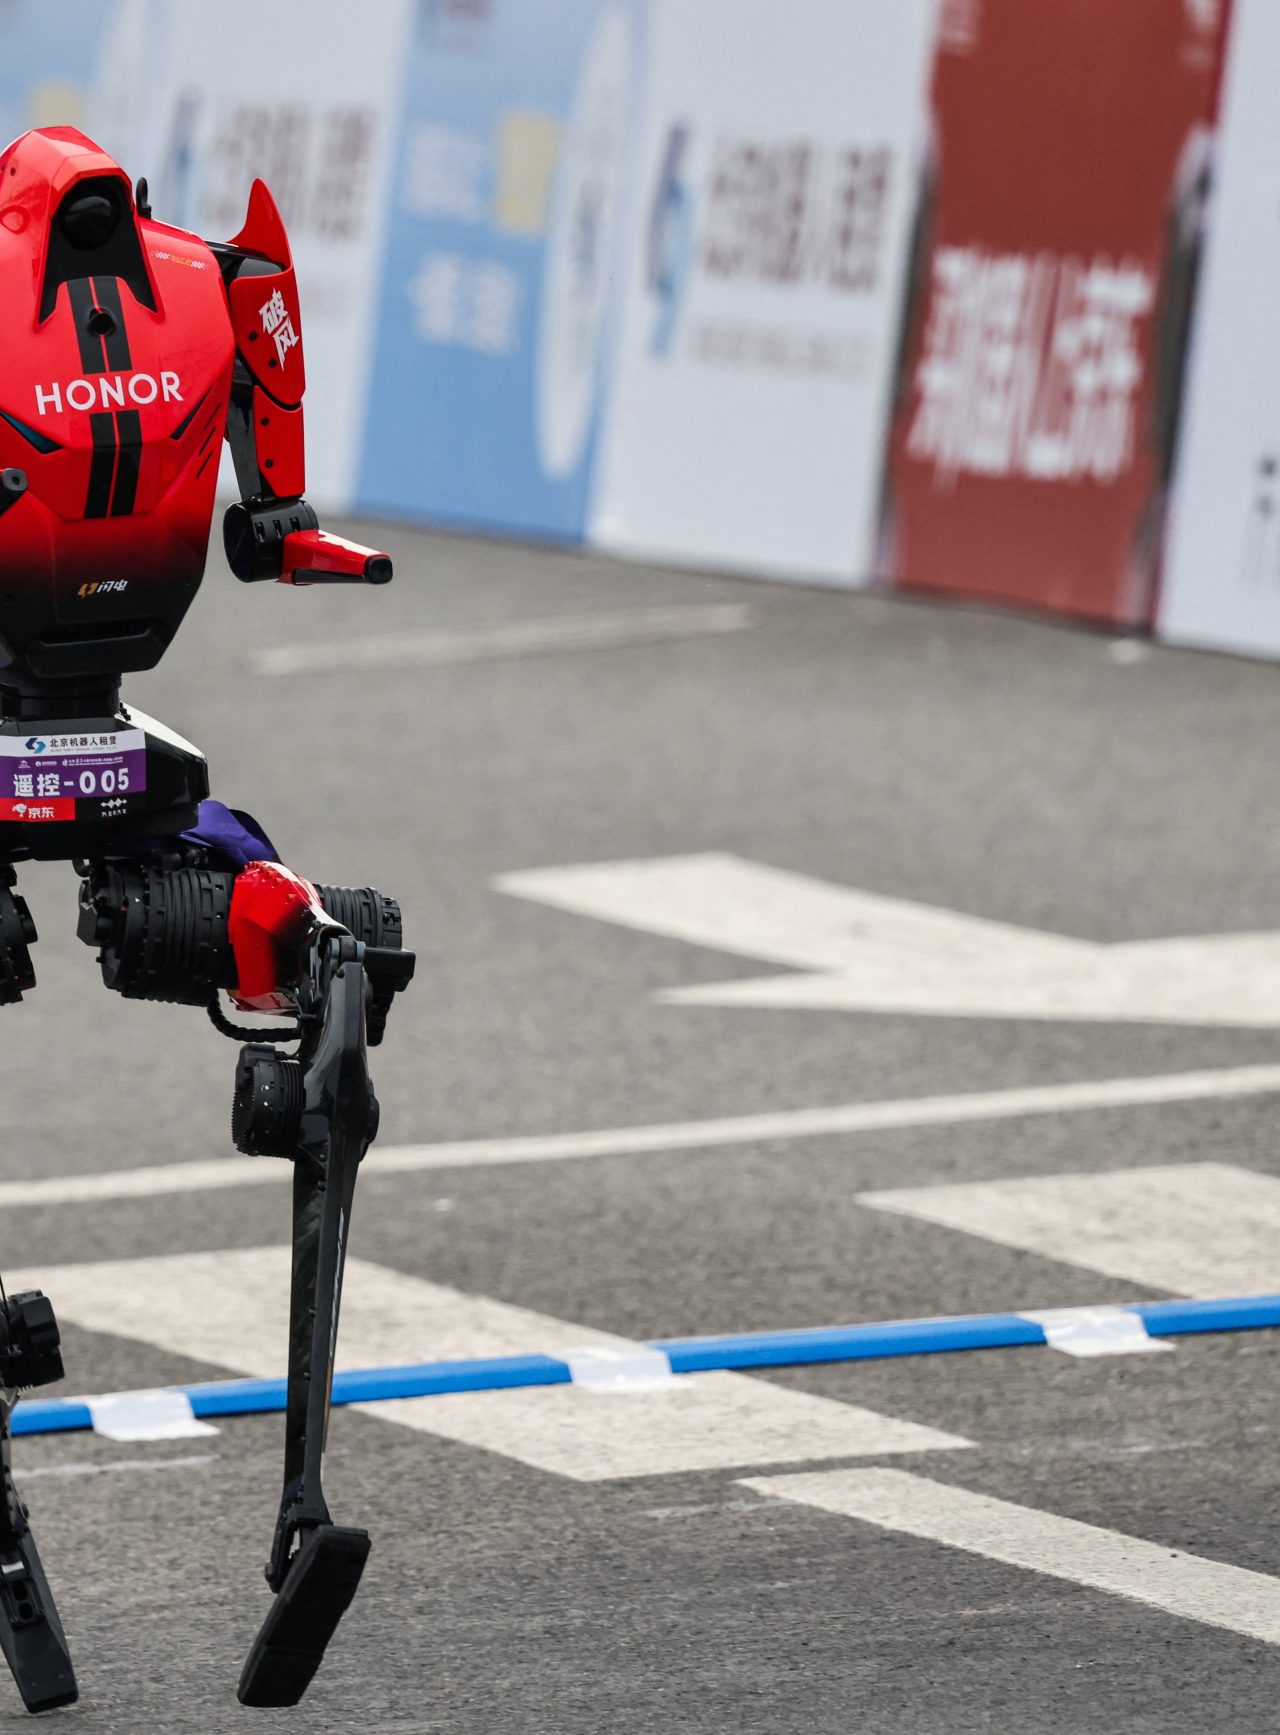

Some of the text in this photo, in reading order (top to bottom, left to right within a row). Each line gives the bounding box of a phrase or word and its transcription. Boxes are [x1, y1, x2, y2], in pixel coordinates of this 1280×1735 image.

[258, 287, 300, 372] 破风
[34, 371, 184, 416] HONOR
[96, 579, 128, 593] 闪电
[49, 735, 117, 748] 北京机器人租赁
[13, 767, 130, 797] 遥控-005
[28, 806, 55, 819] 京东
